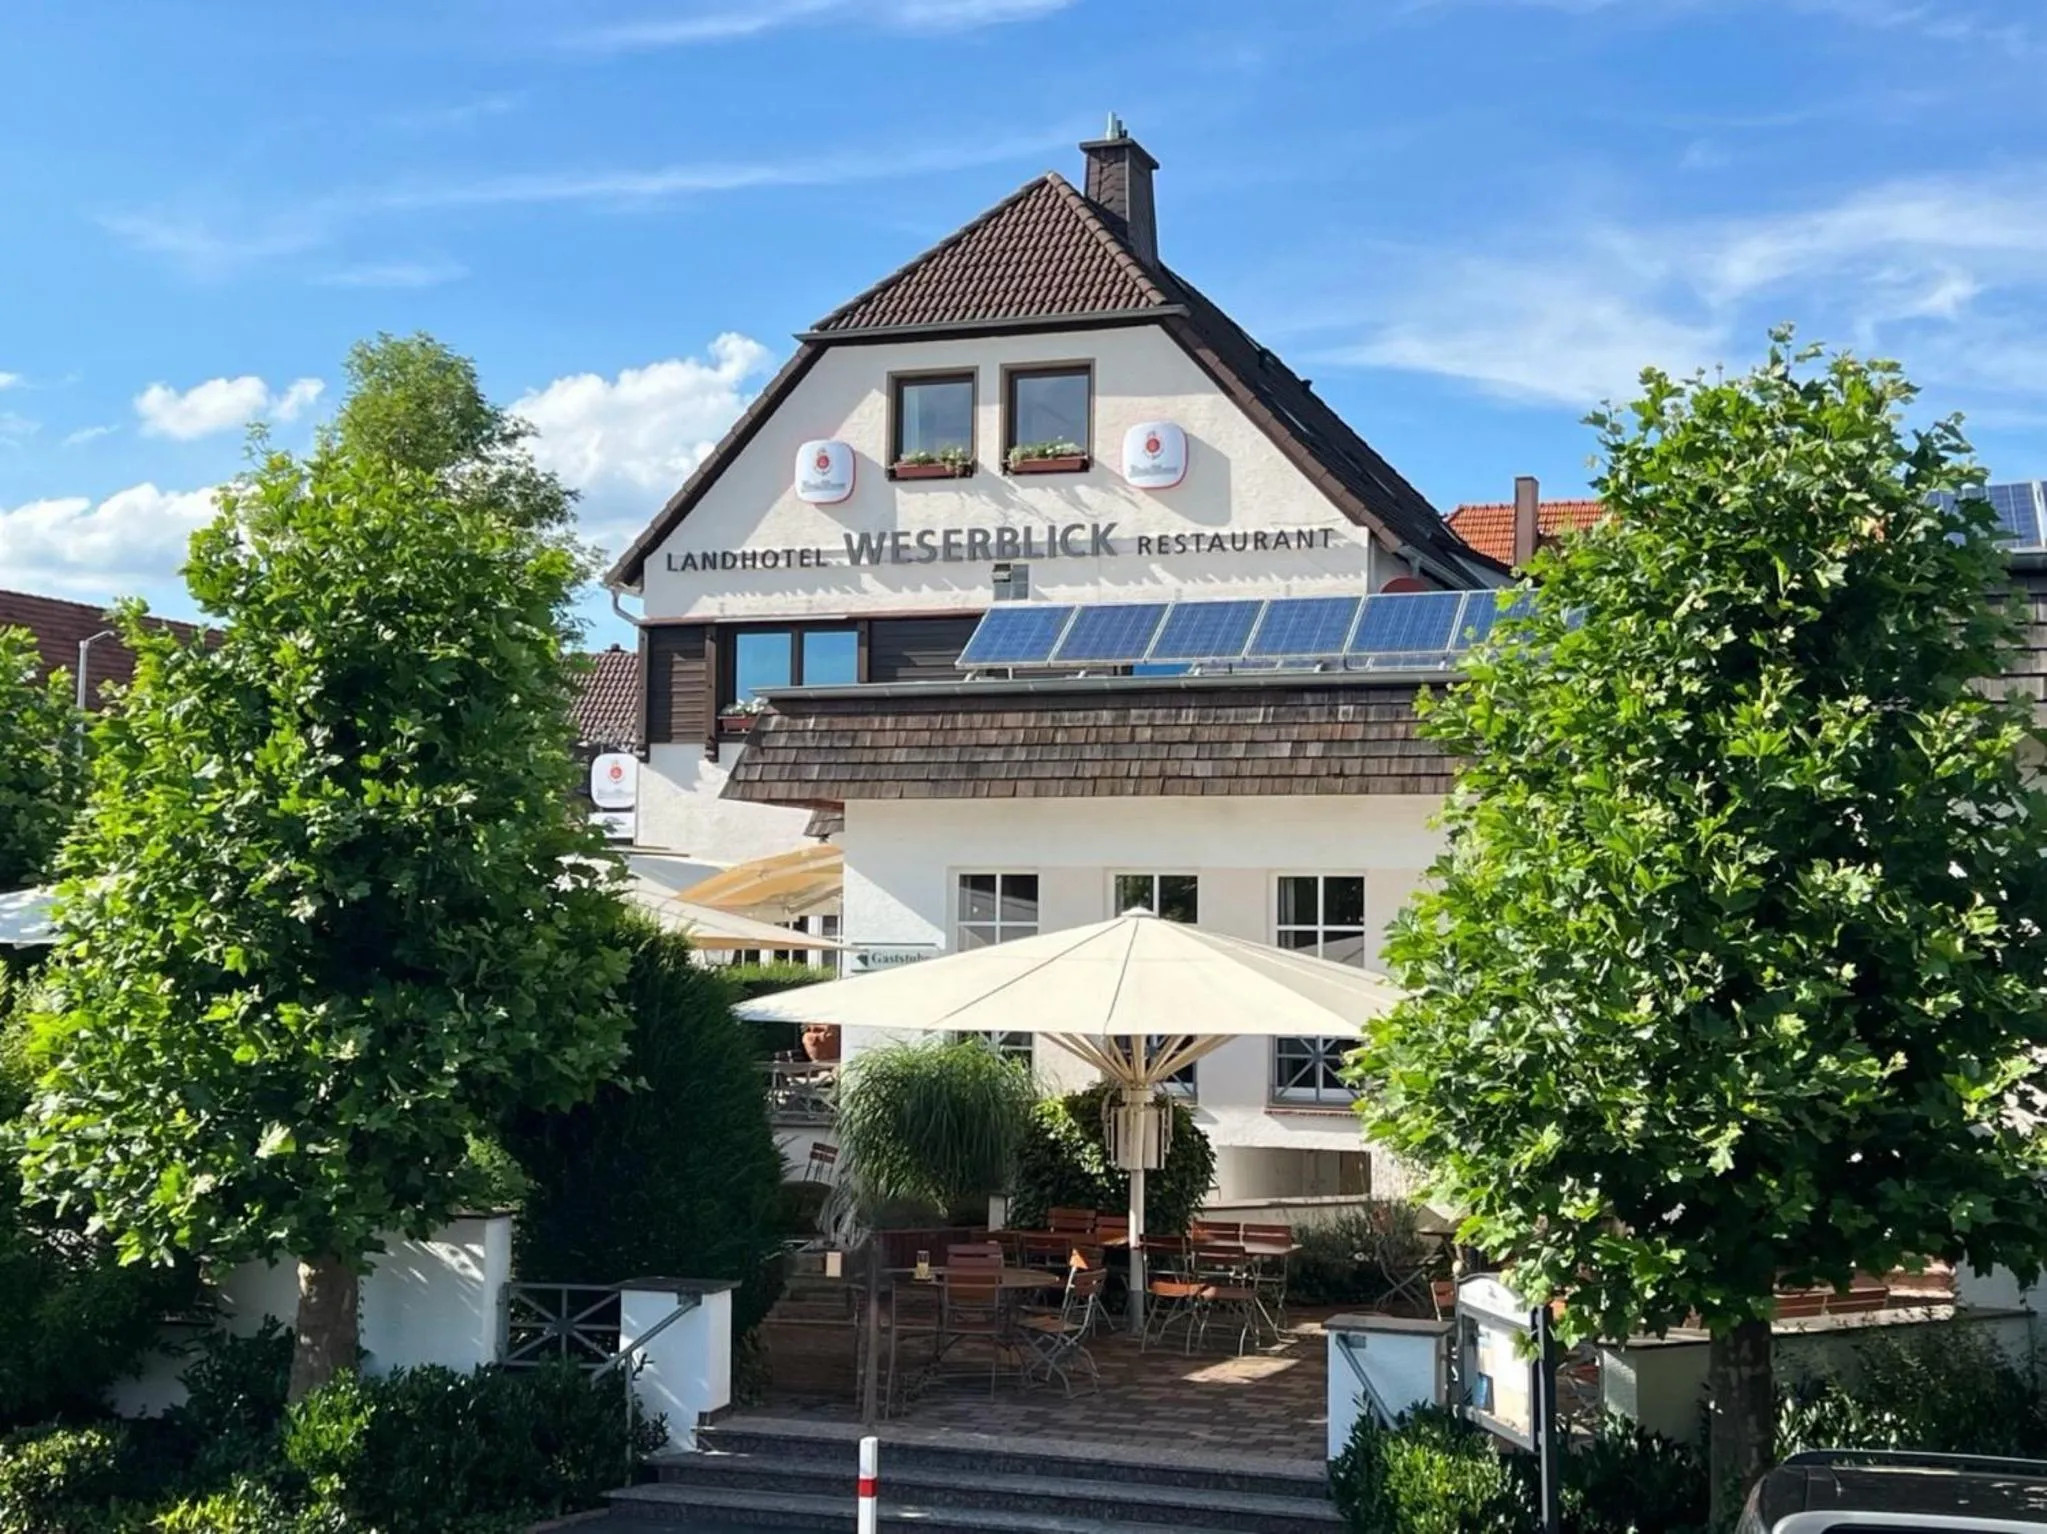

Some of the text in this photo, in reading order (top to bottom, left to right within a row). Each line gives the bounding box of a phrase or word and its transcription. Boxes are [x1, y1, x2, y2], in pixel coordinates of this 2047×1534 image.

[667, 522, 1334, 571] LANDHOTEL WESERBLICK RESTAURANT
